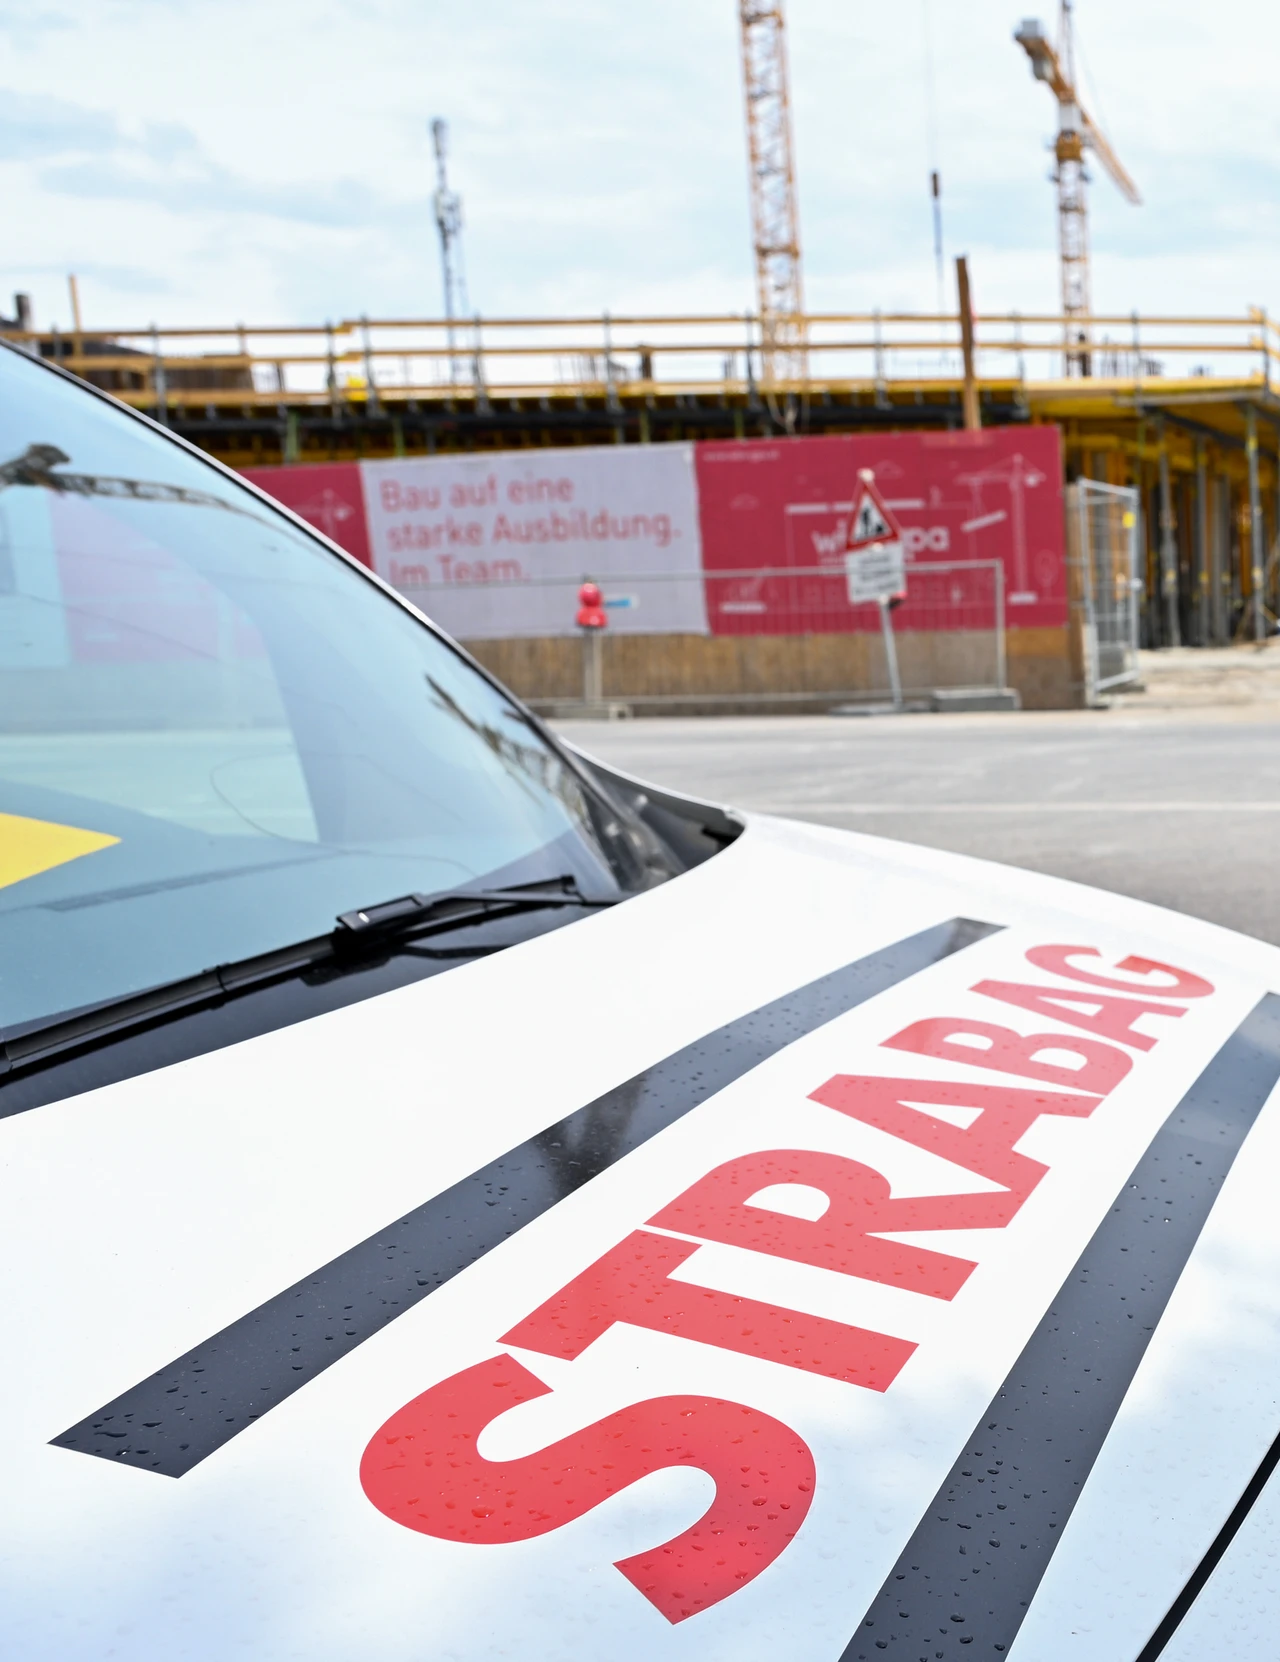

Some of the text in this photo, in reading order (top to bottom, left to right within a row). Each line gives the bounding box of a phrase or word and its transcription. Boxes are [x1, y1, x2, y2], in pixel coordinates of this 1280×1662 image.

[379, 471, 574, 512] Bau auf eine
[387, 507, 683, 551] starke Ausbildung.
[388, 553, 532, 585] Im Team.
[359, 943, 1216, 1625] STRABAG
